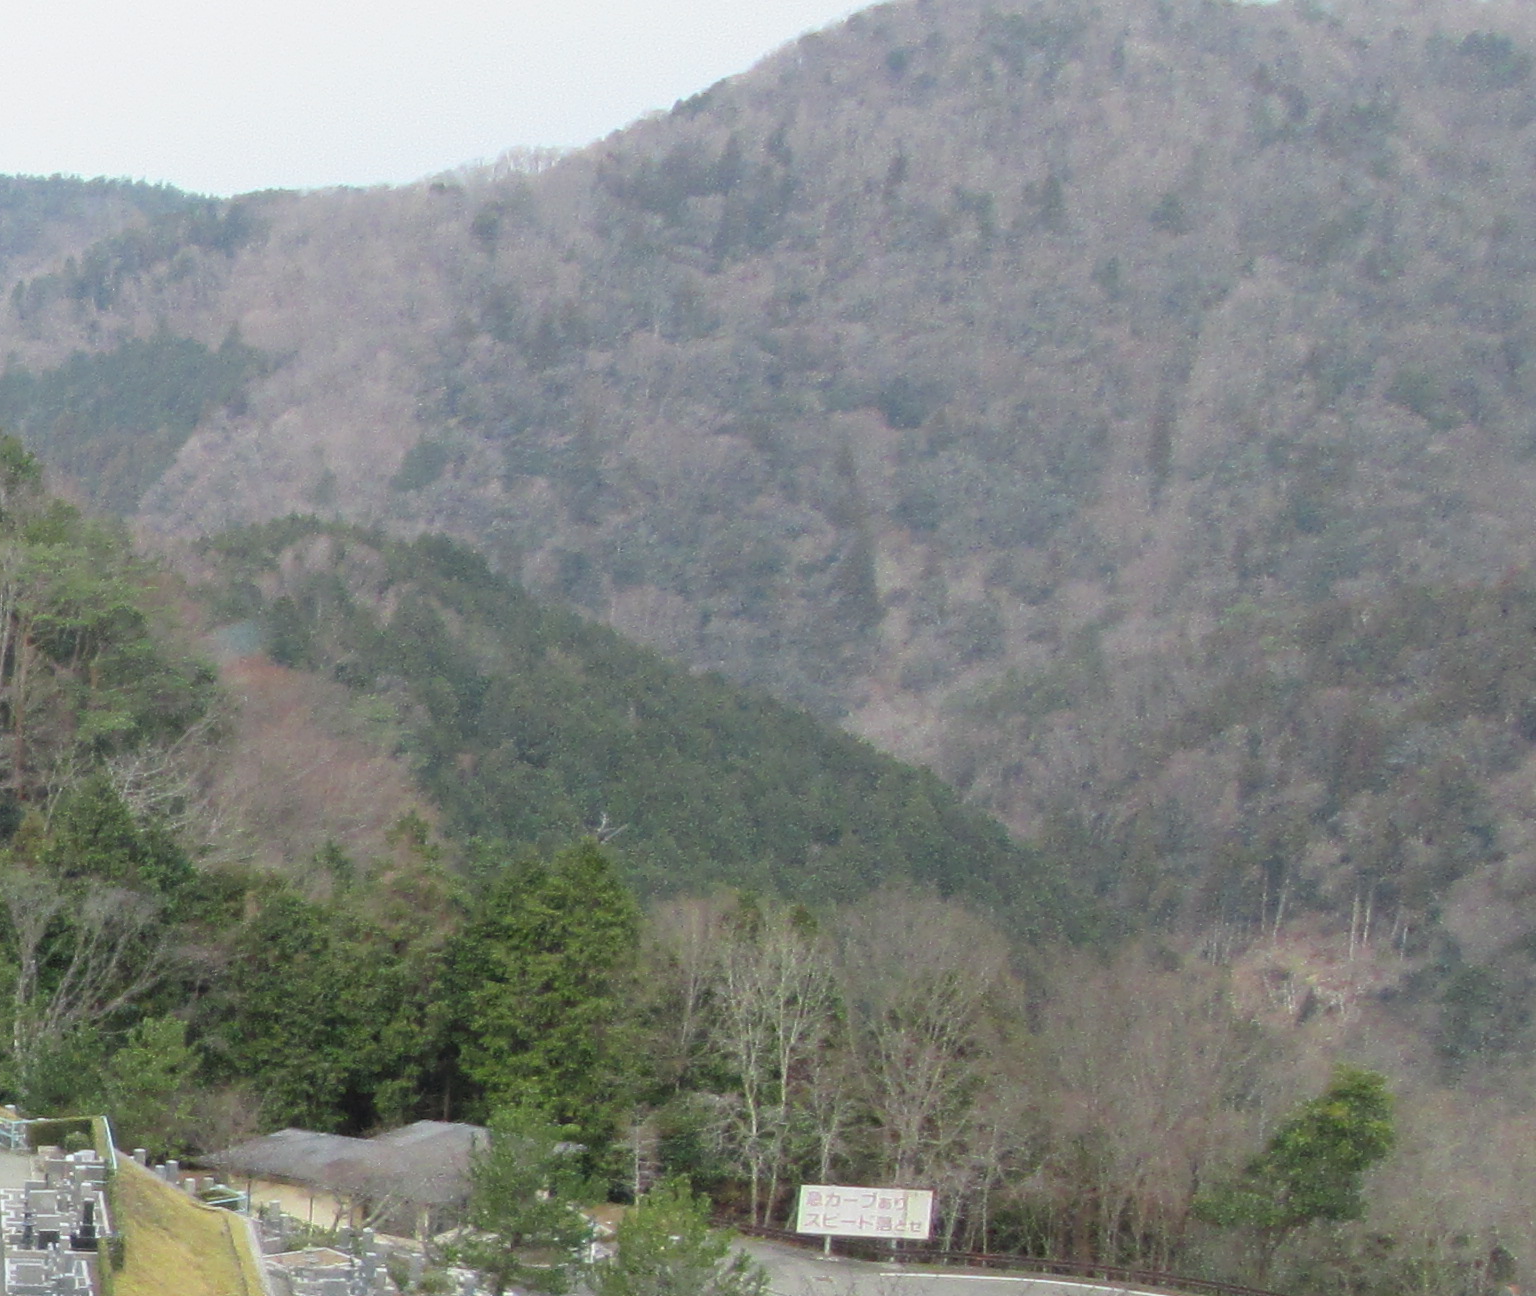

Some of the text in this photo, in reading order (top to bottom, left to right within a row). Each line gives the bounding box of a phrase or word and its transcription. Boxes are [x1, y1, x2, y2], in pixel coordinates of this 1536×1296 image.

[806, 1190, 906, 1211] 急カーブあり
[803, 1213, 921, 1233] スピード落とせ
